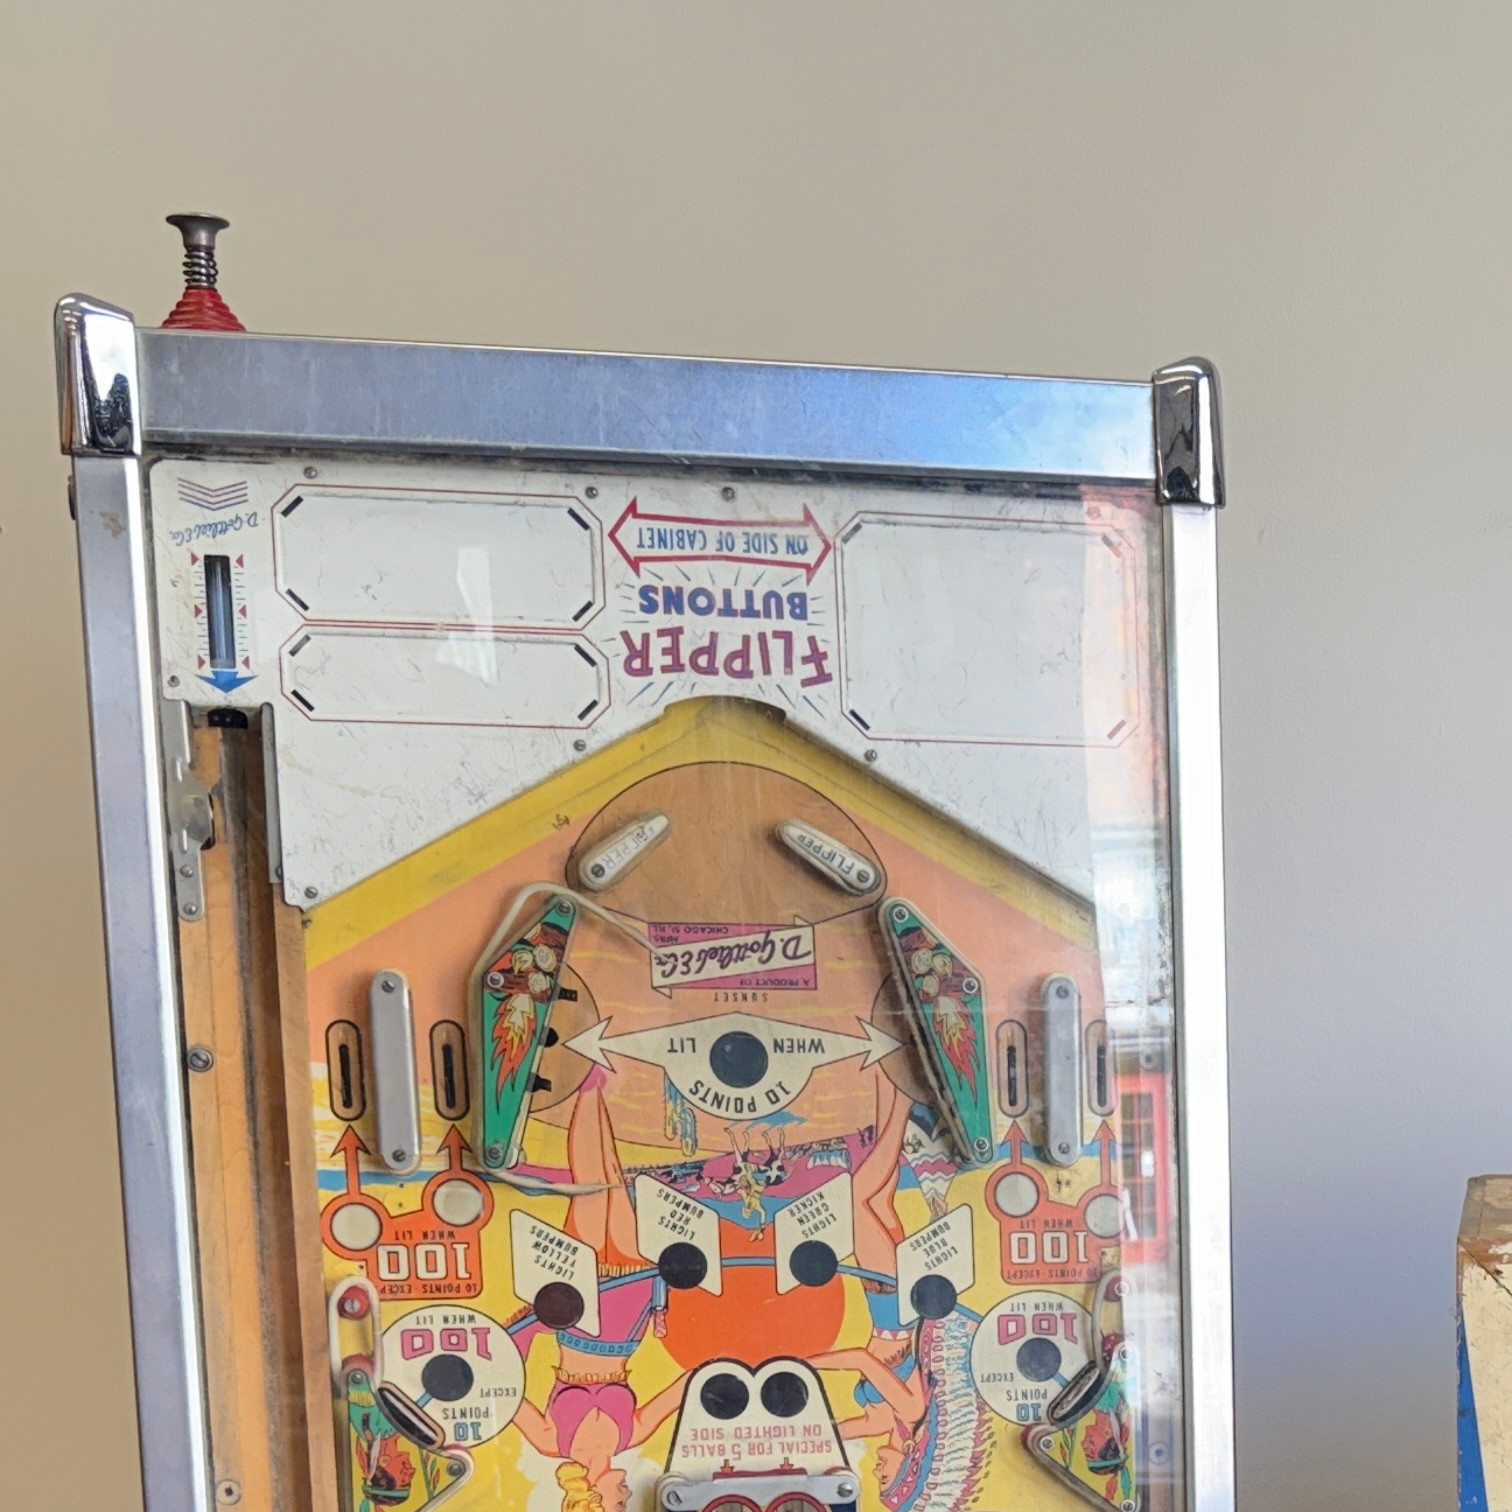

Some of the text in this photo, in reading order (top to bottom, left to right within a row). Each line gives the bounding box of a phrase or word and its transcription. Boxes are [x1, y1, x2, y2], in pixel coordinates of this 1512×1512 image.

[194, 513, 243, 539] Gottlieb
[637, 527, 808, 555] ON SIDE OF CABINET
[638, 585, 808, 621] BUTTONS
[620, 626, 832, 688] FLIPPER
[798, 834, 855, 875] FLIPPER
[684, 926, 728, 934] CHICAGO
[694, 930, 775, 974] Gottlieb
[780, 935, 811, 960] D.
[756, 978, 798, 986] PRODUCT
[802, 978, 810, 987] A
[713, 992, 768, 1002] SUNSET
[667, 1038, 825, 1053] WHEN LIT
[688, 1080, 791, 1114] 10 POINTS
[657, 1188, 704, 1219] BUMPERS
[787, 1191, 825, 1217] KICKER
[670, 1209, 691, 1225] RED
[797, 1203, 829, 1226] GREEN
[1020, 1219, 1073, 1229] WHEN LIT
[394, 1230, 455, 1240] WHEN LIT
[658, 1216, 695, 1240] LIGHTS
[801, 1213, 837, 1239] LIGHTS
[909, 1221, 951, 1251] BUMPERS
[529, 1225, 579, 1256] BUMPERS
[923, 1238, 948, 1258] BLUE
[1009, 1231, 1089, 1265] 100
[376, 1243, 471, 1281] 100
[531, 1241, 576, 1268] YELLOW
[924, 1246, 958, 1271] LIGHTS
[534, 1255, 575, 1280] LIGHTS
[1006, 1270, 1040, 1279] EXCEPT
[1048, 1268, 1082, 1278] POINTS
[379, 1283, 477, 1294] 10 POINTS EXCEP
[1010, 1302, 1063, 1311] WHEN LIT
[416, 1314, 476, 1325] WHEN LIT
[997, 1313, 1078, 1345] 100
[401, 1328, 492, 1361] 100
[981, 1373, 1014, 1383] EXCEPT
[479, 1387, 517, 1398] EXCEPT
[1006, 1388, 1047, 1401] POINTS
[442, 1407, 489, 1420] POINTS
[1016, 1403, 1041, 1421] 10
[453, 1422, 482, 1441] 10
[690, 1424, 821, 1441] ON LIGHTED SIDE
[681, 1440, 832, 1460] SPECIAL FOR 5 BALLS
